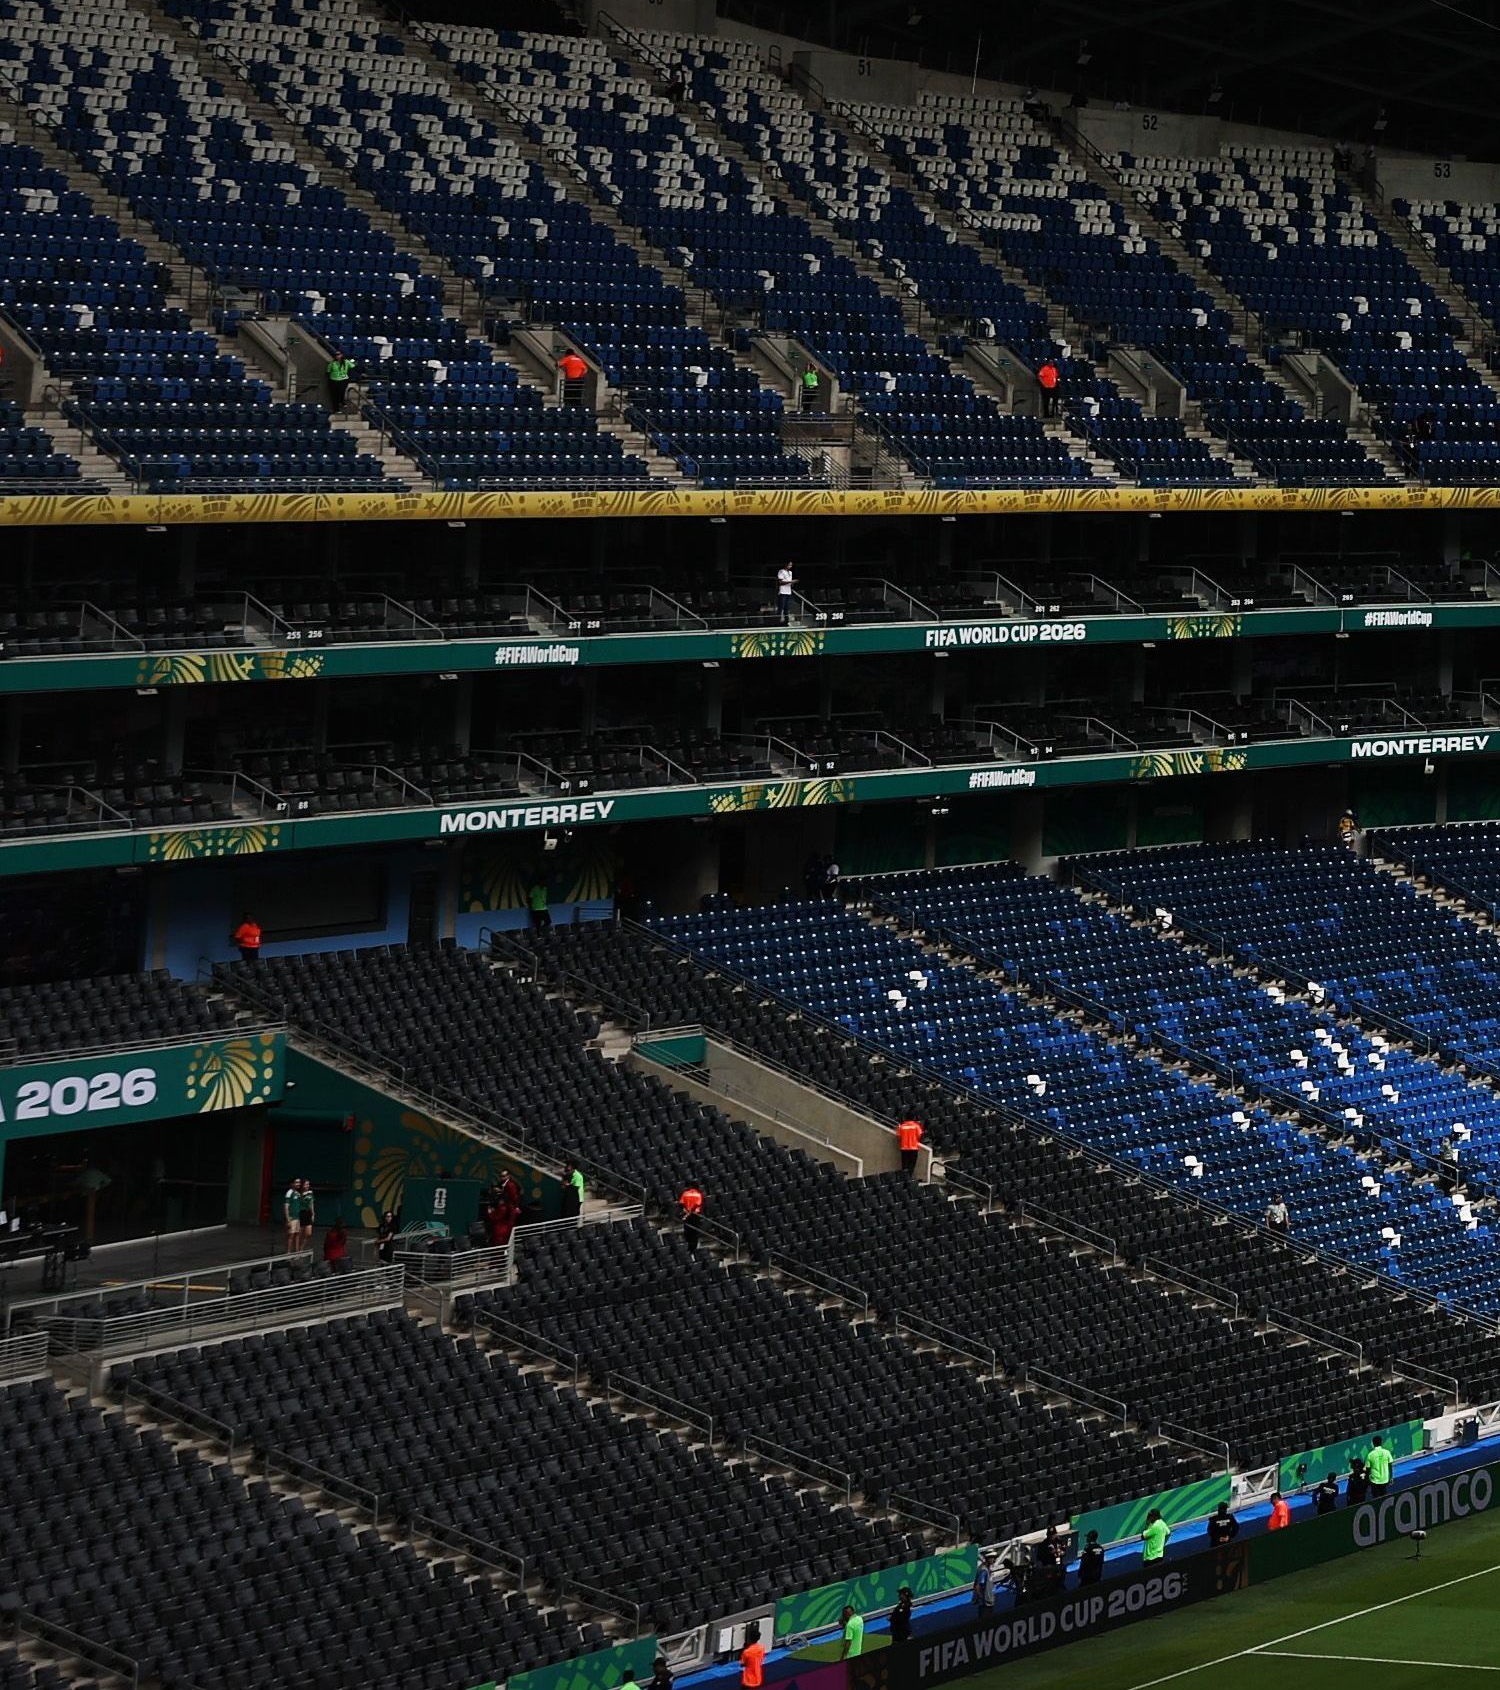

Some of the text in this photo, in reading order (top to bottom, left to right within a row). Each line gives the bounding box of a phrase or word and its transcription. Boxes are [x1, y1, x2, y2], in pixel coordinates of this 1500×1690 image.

[857, 58, 872, 76] 51
[1142, 115, 1157, 130] 52
[1434, 163, 1451, 178] 53
[568, 621, 582, 630] 257
[587, 620, 600, 629] 258
[286, 631, 302, 640] 255
[308, 630, 323, 639] 256
[926, 624, 1085, 646] FIFA WORLD CUP 2026
[495, 645, 579, 665] #FIFAWorldCup
[1351, 735, 1489, 757] MONTERREY
[440, 800, 614, 833] MONTERREY
[17, 1069, 157, 1120] 2026
[1352, 1470, 1493, 1547] aramco
[919, 1635, 968, 1678] FIFA
[972, 1610, 1055, 1660] WORLD
[1060, 1597, 1104, 1633] CUP
[1107, 1573, 1181, 1619] 2026
